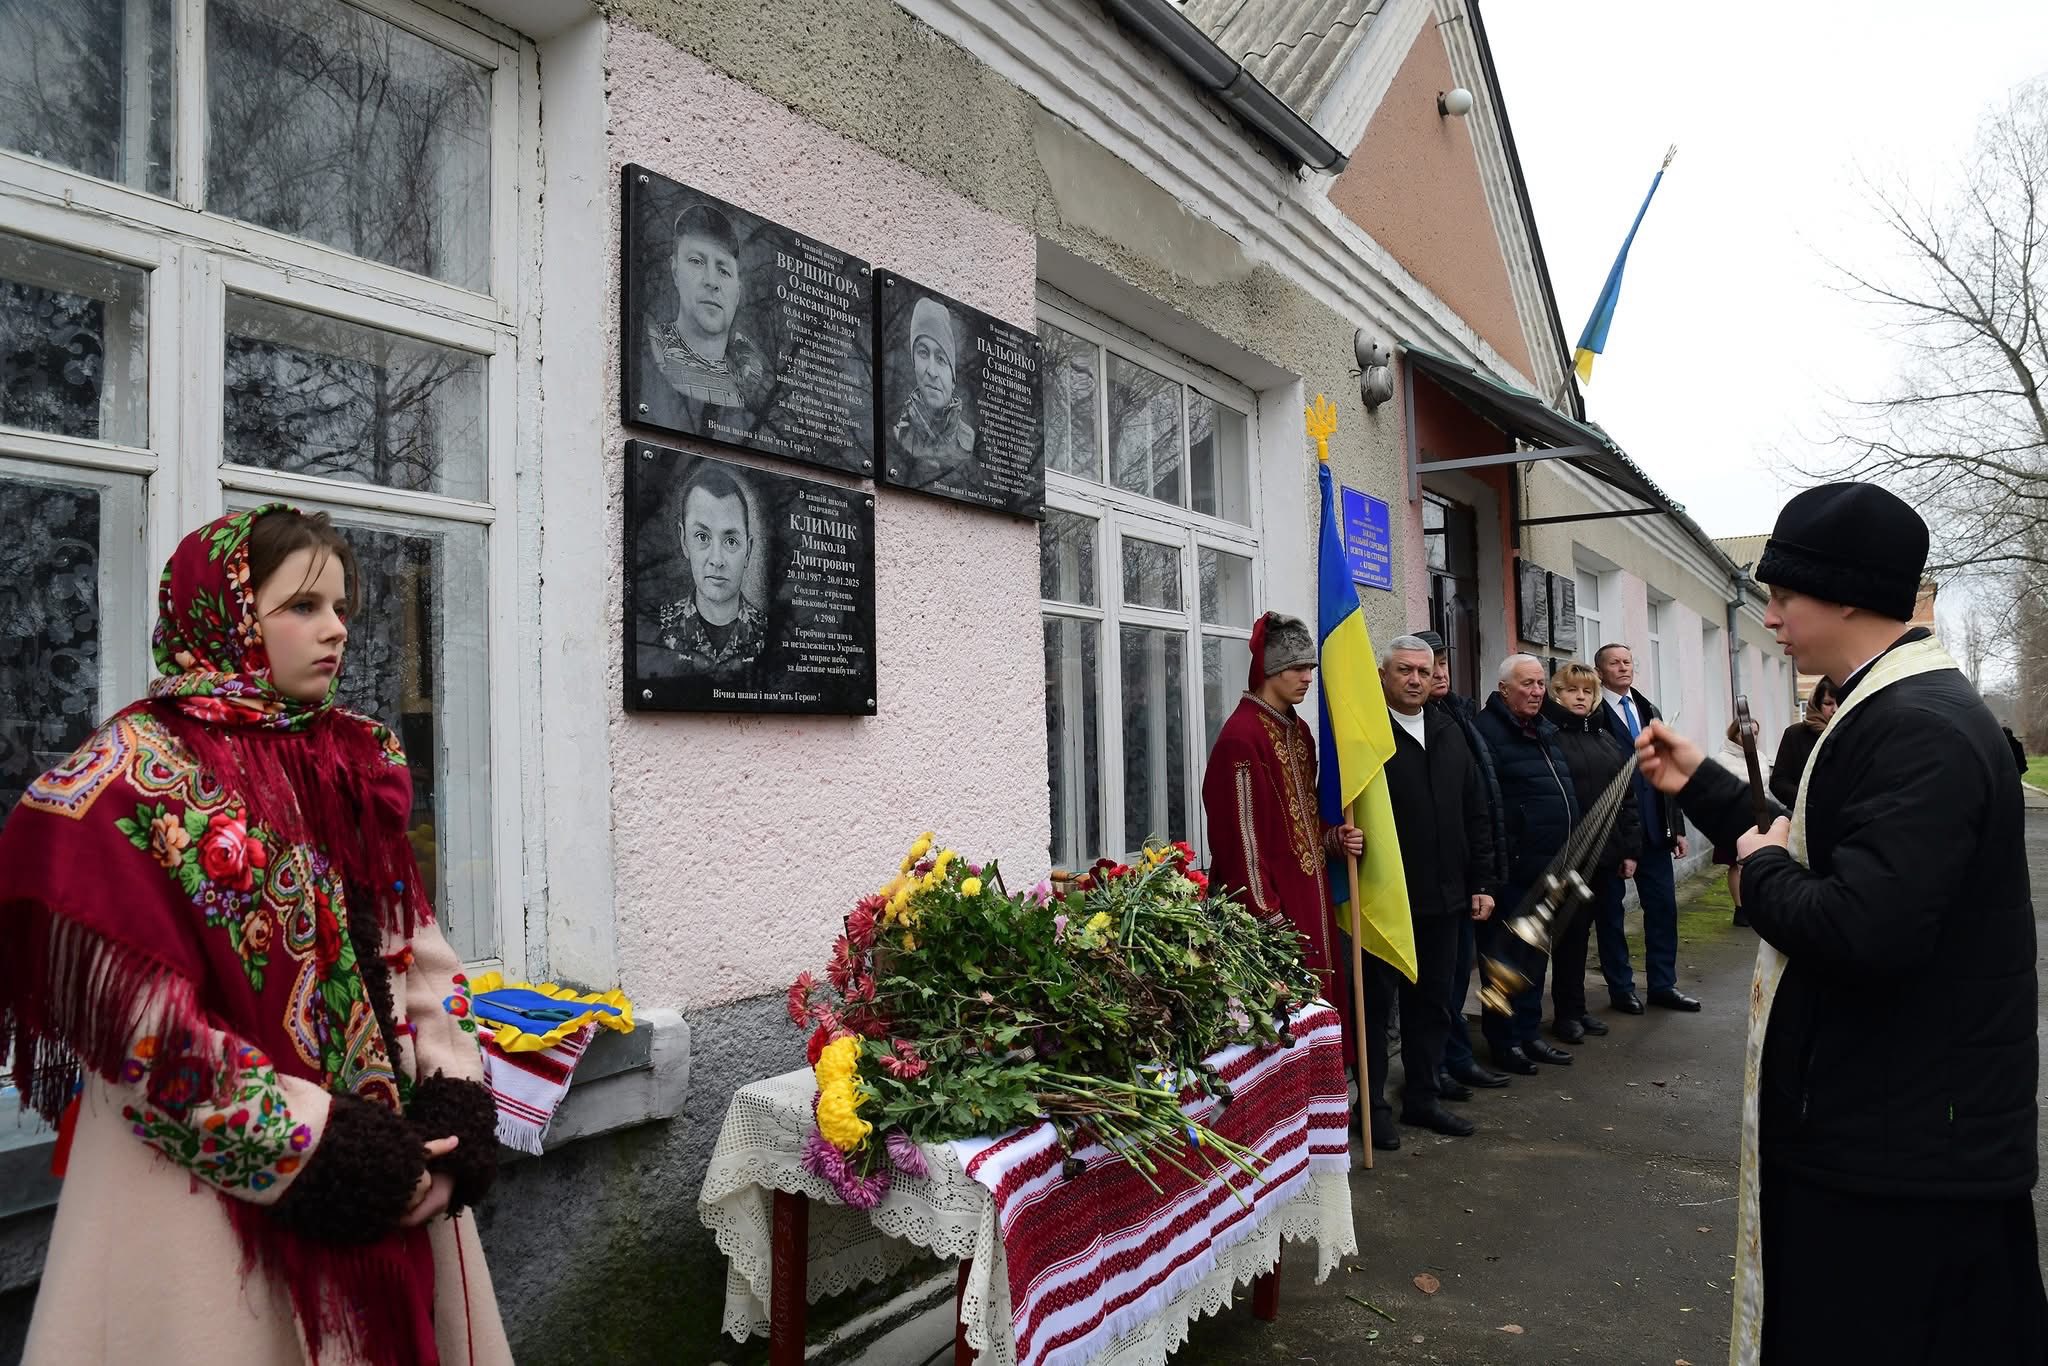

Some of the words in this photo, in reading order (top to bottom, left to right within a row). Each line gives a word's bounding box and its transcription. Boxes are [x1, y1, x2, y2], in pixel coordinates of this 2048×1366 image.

[777, 251, 860, 298] ВЕРШИГОРА
[789, 274, 849, 310] Олександр
[777, 285, 861, 327] Олександрович
[977, 336, 1036, 372] ПАЛЬОНКО
[987, 356, 1027, 381] Станіслав
[982, 367, 1031, 396] Олексійович
[799, 490, 805, 499] В
[806, 494, 827, 504] нашій
[828, 498, 848, 508] школі
[808, 504, 840, 517] навчався
[790, 513, 857, 540] КЛИМИК
[801, 534, 846, 555] Микола
[791, 550, 855, 573] Дмитрович
[787, 569, 822, 582] 20.10.1987
[794, 584, 819, 596] Солдат
[795, 627, 826, 639] Героїчно
[713, 688, 736, 699] Вічна
[737, 691, 758, 700] шана
[794, 691, 817, 703] Герою
